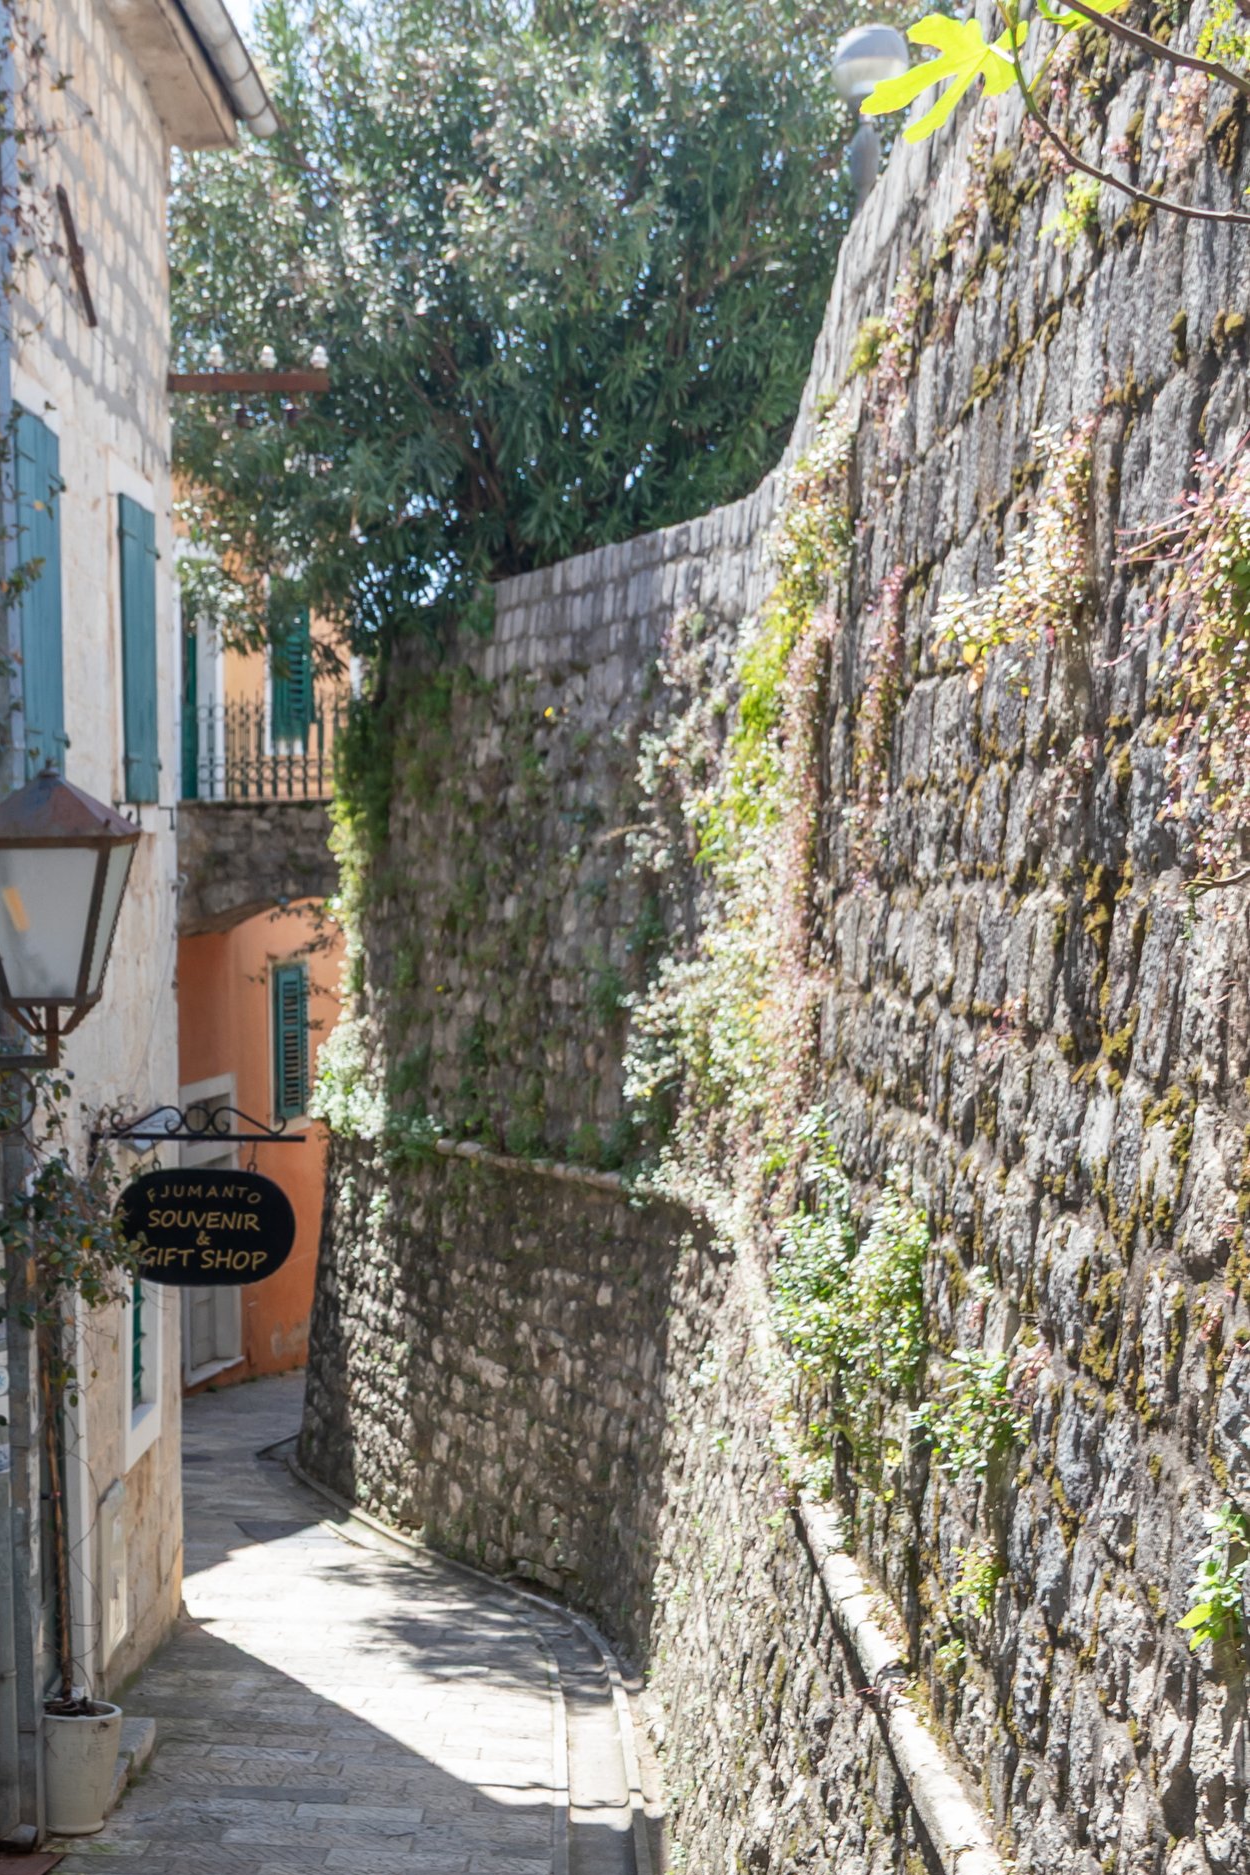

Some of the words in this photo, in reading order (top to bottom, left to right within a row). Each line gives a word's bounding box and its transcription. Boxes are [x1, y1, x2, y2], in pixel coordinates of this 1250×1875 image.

[148, 1209, 261, 1231] SOUVENIR
[196, 1230, 211, 1246] &
[140, 1247, 195, 1267] GIFT
[200, 1249, 268, 1271] SHOP
